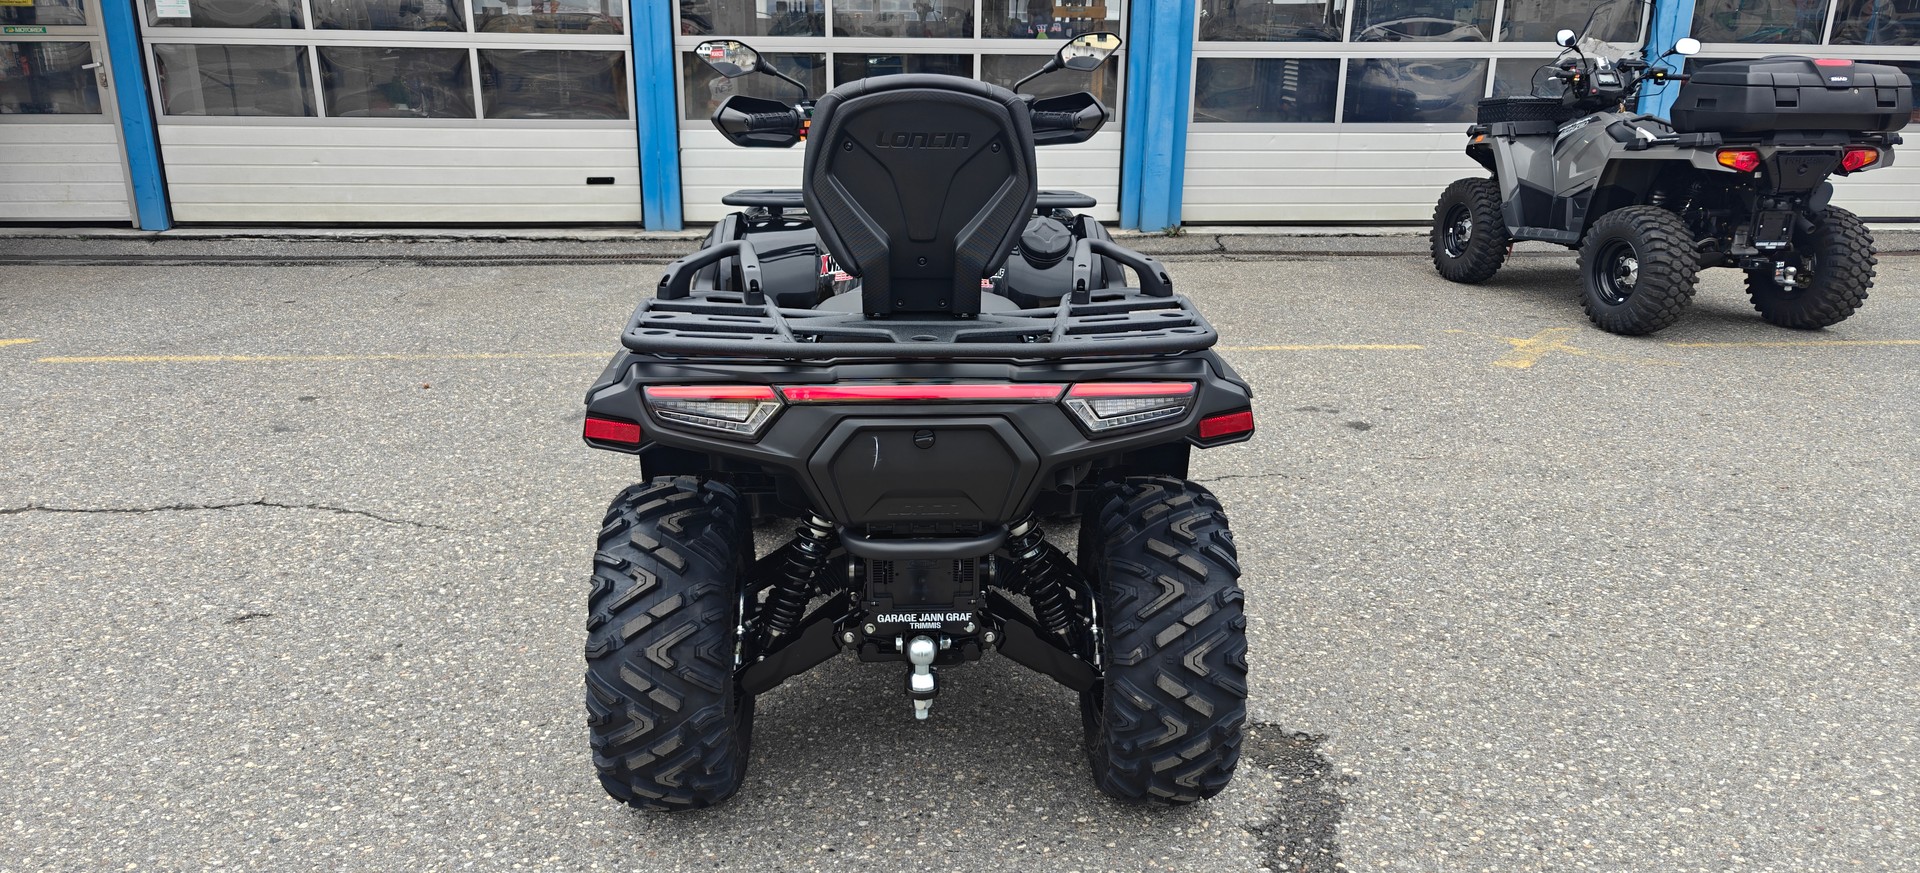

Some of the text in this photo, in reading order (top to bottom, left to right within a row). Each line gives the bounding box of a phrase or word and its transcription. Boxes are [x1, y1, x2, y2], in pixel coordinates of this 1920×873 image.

[876, 132, 971, 149] LONCIN
[877, 612, 973, 623] GARAGE JANN GRAF
[909, 622, 942, 630] TRIMMIS
